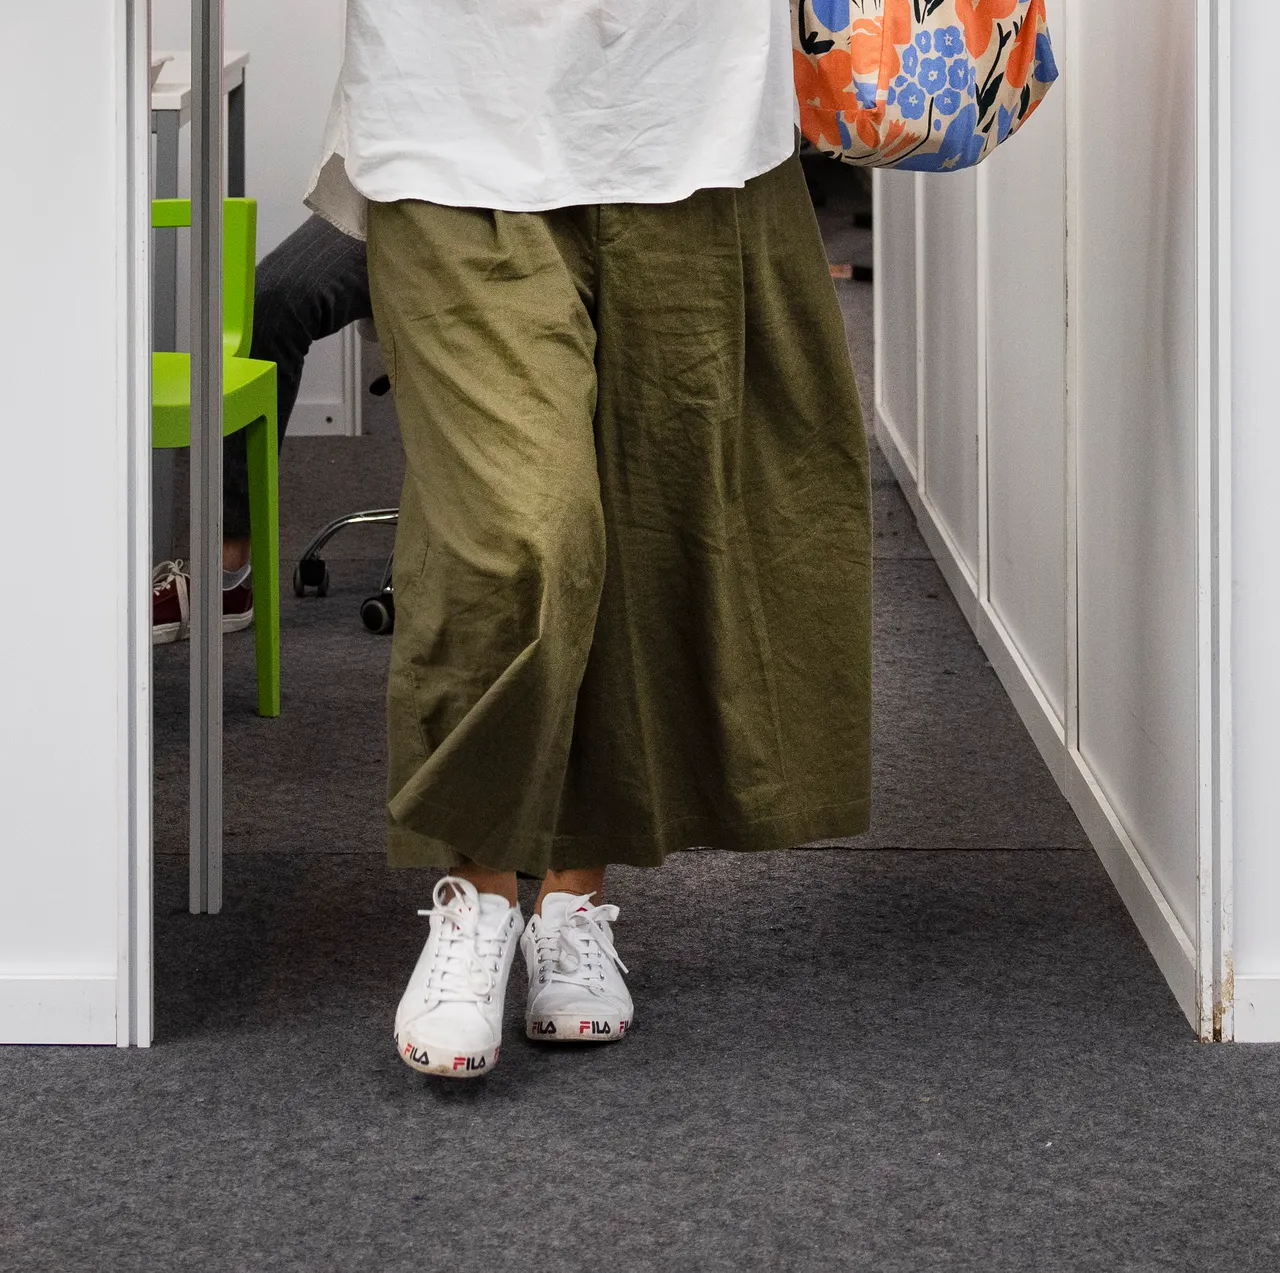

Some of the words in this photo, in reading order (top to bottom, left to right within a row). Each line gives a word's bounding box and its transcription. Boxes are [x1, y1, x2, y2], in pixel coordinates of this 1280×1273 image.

[532, 1020, 557, 1035] FILA
[579, 1020, 611, 1035] FILA
[403, 1042, 430, 1066] FILA
[452, 1056, 486, 1071] FILA
